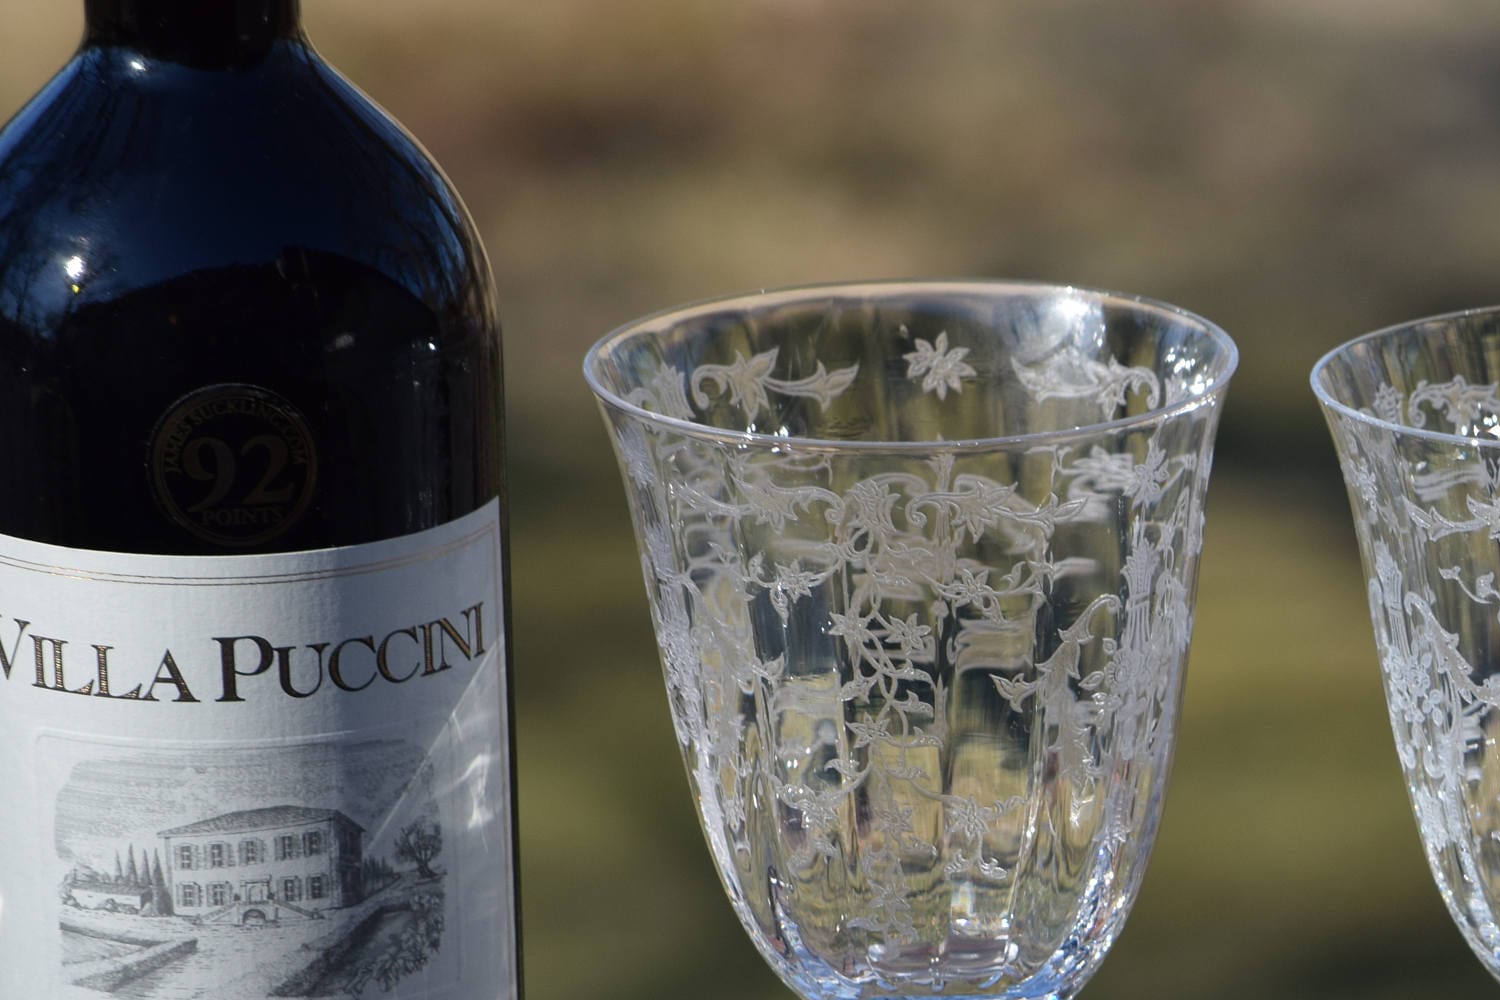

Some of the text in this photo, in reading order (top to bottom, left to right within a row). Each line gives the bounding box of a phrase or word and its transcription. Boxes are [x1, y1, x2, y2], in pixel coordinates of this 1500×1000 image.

[182, 434, 294, 512] 92
[202, 506, 284, 527] POINTS
[0, 602, 486, 703] VILLA PUCCINI
